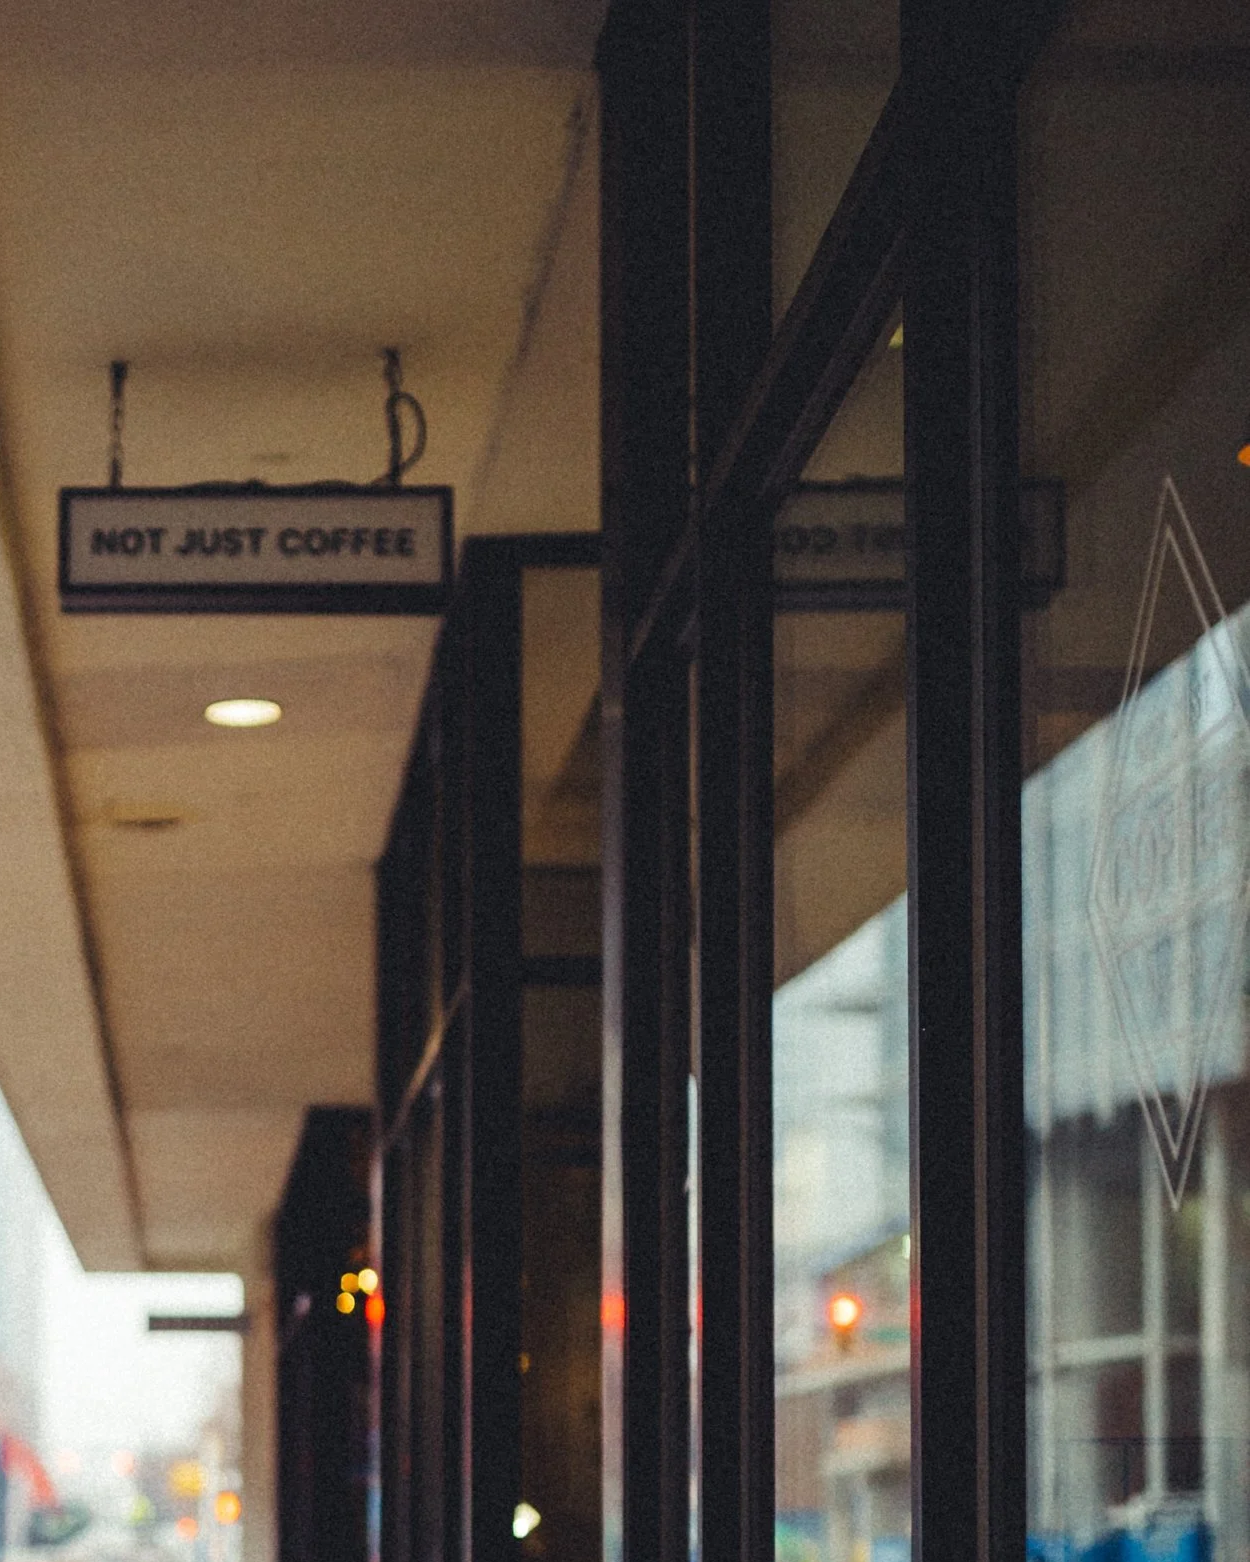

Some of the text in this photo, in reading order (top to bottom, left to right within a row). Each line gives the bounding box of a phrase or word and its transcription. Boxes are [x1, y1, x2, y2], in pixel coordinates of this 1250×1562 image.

[90, 526, 417, 557] NOT JUST COFFEE
